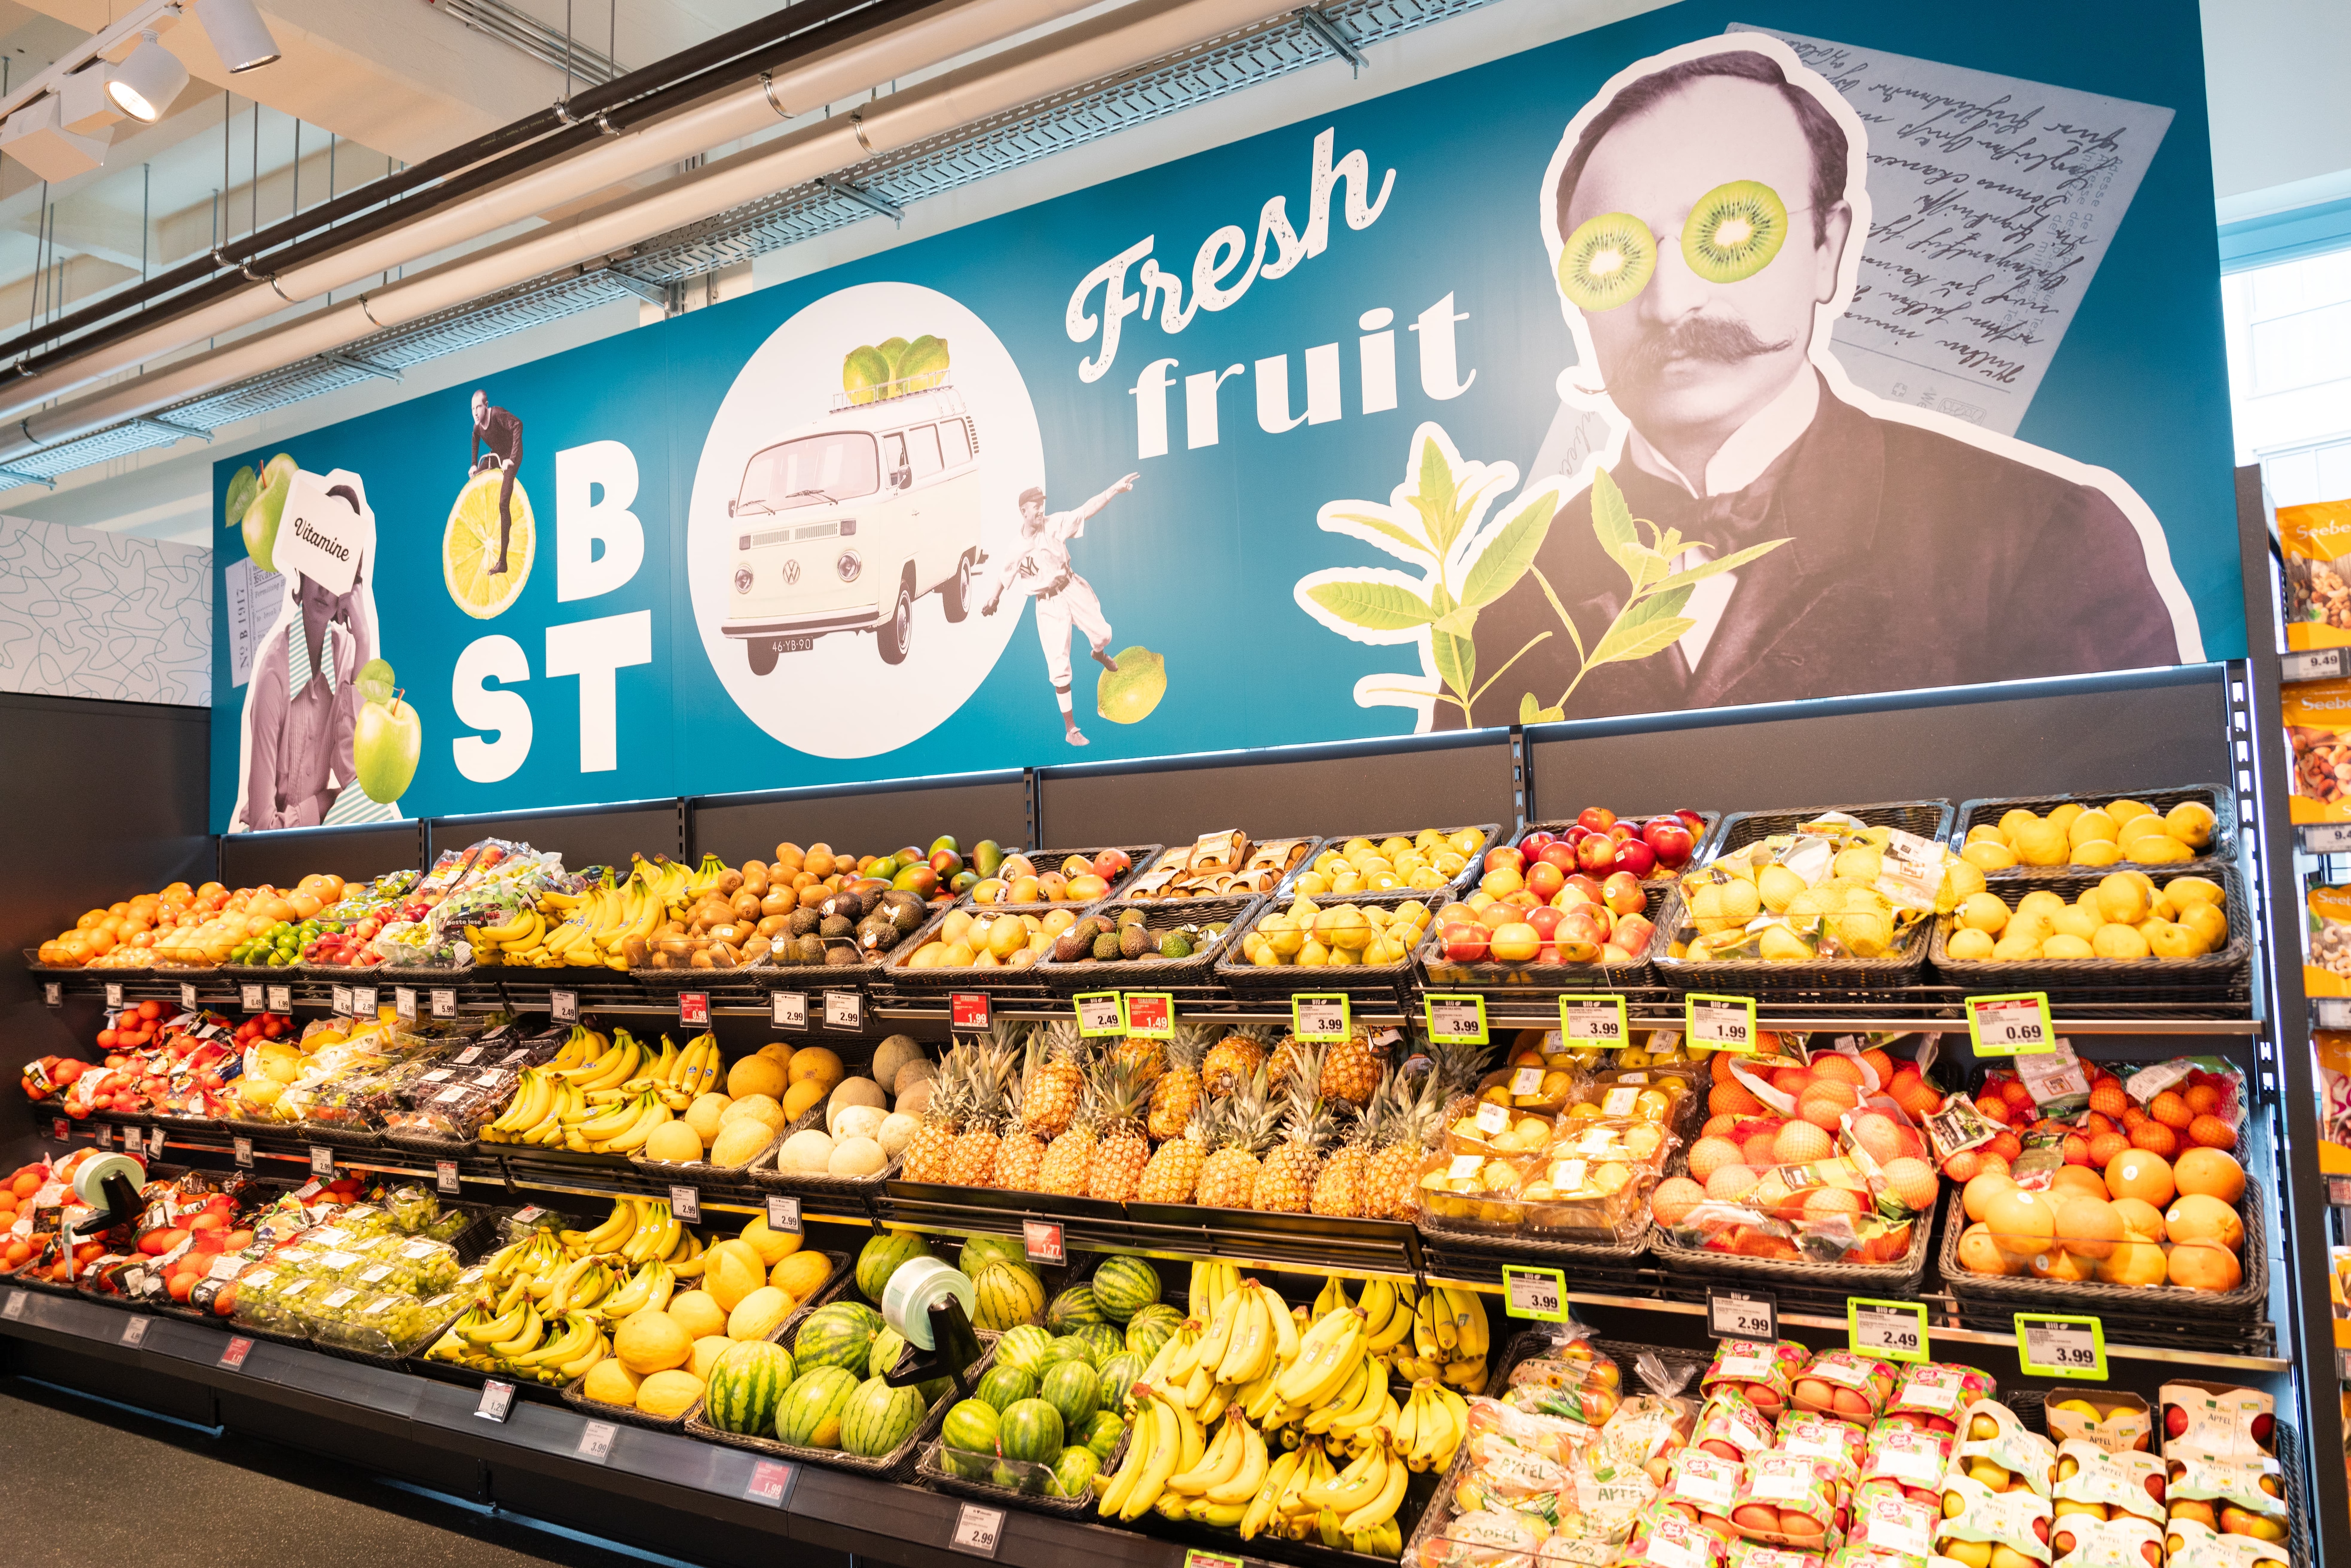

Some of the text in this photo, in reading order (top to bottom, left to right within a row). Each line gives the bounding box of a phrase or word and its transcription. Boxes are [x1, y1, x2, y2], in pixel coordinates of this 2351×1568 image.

[1066, 127, 1396, 383] Fresh
[1129, 290, 1476, 460] fruit
[294, 518, 349, 561] Vitamine
[237, 588, 246, 623] 1917
[2311, 655, 2337, 667] 9.49
[453, 610, 651, 782] ST
[341, 1003, 351, 1012] 5.90
[562, 1008, 574, 1016] 2.49
[692, 1010, 706, 1019] 0.99
[787, 1011, 803, 1021] 2.99
[840, 1012, 858, 1022] 2.99
[968, 1013, 986, 1024] 1.99
[1097, 1015, 1118, 1024] 2.49
[1146, 1016, 1168, 1027] 1.49
[1318, 1019, 1342, 1030] 3.99
[1453, 1020, 1478, 1031] 3.99
[1590, 1023, 1618, 1034] 3.99
[1717, 1024, 1746, 1038] 1.99
[2006, 1025, 2041, 1039] 0.69
[682, 1205, 695, 1214] 2.99
[781, 1215, 797, 1225] 2.99
[1042, 1243, 1060, 1255] 1.77
[1531, 1295, 1557, 1308] 3.99
[1731, 1292, 1742, 1300] BIO
[1738, 1316, 1768, 1331] 2.99
[1884, 1331, 1917, 1346] 2.49
[2056, 1348, 2093, 1363] 3.99
[491, 1401, 505, 1413] 1.29
[591, 1442, 607, 1454] 3.99
[764, 1481, 781, 1495] 1.99
[972, 1530, 994, 1544] 2.99
